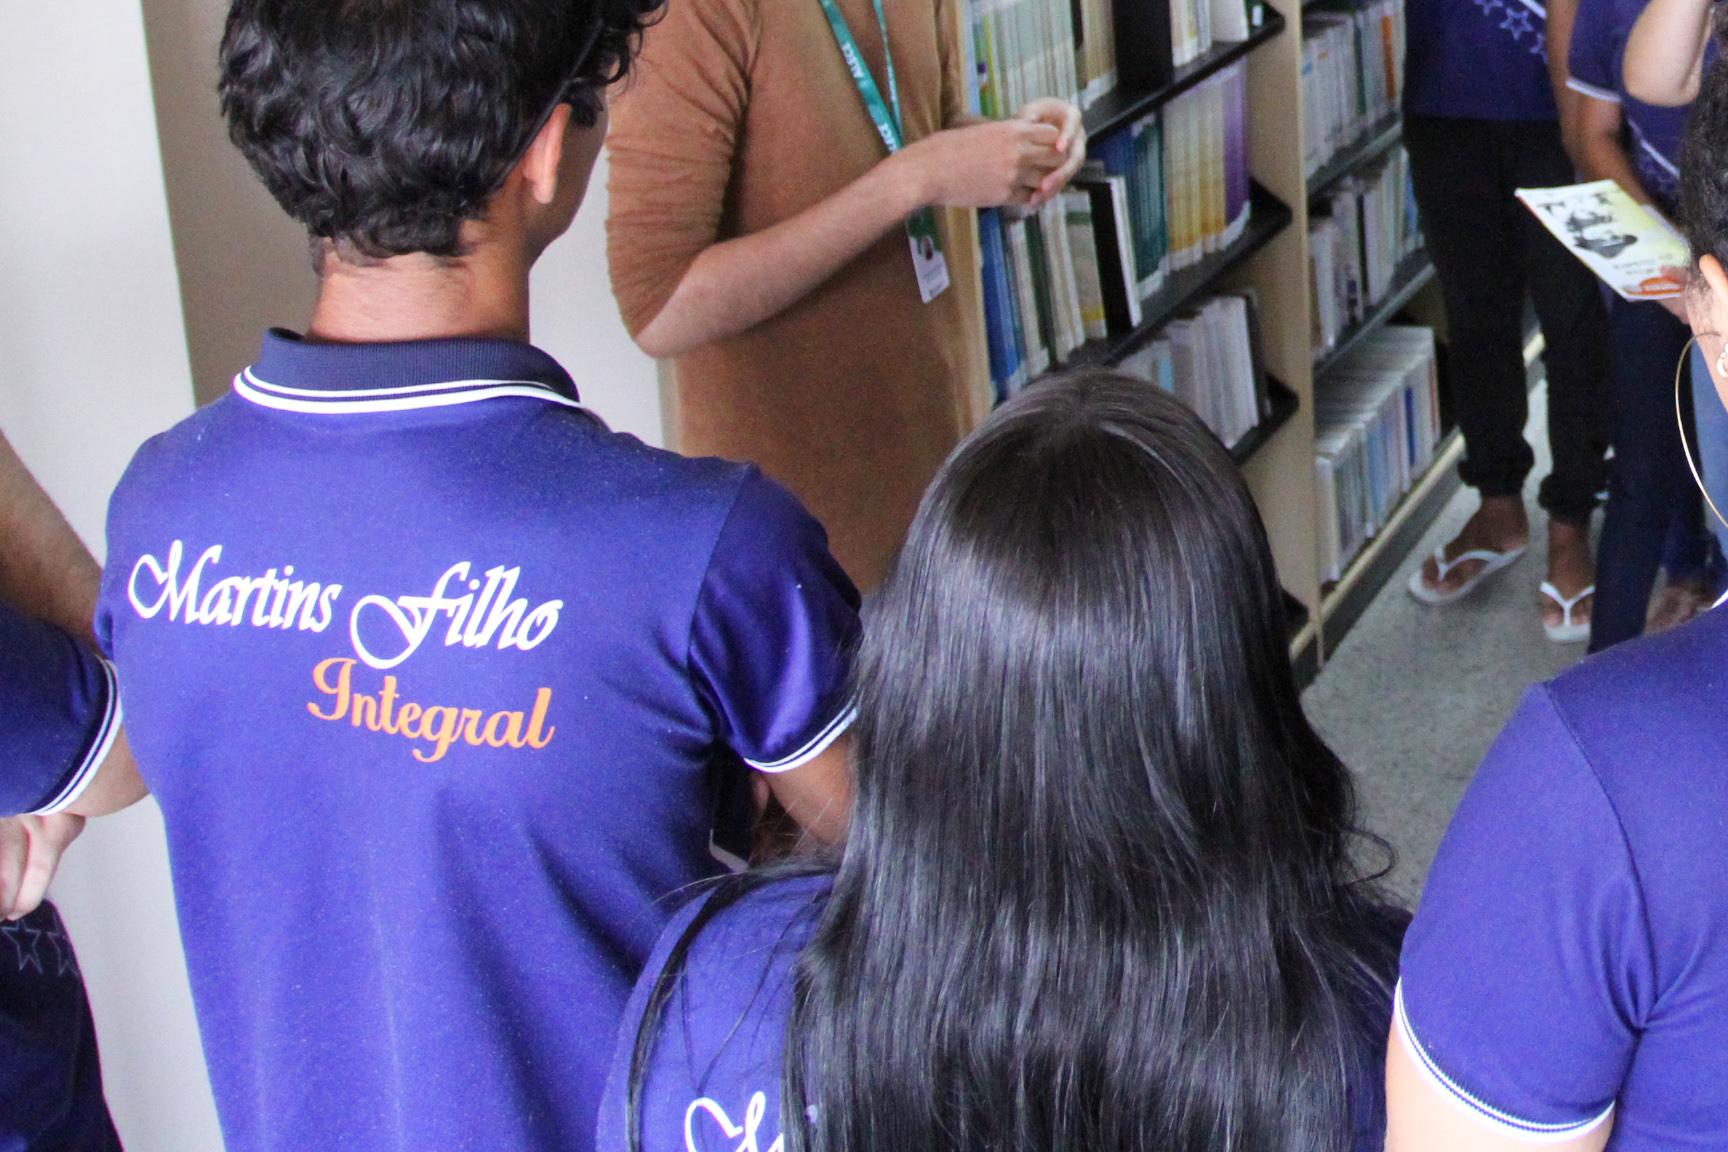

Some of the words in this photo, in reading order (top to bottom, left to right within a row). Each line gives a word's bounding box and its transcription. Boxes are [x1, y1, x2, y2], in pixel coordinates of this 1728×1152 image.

[841, 41, 865, 79] ALECE
[877, 123, 899, 156] LECE
[128, 539, 342, 632] Martins
[350, 560, 563, 670] Filho
[307, 657, 555, 763] Integral
